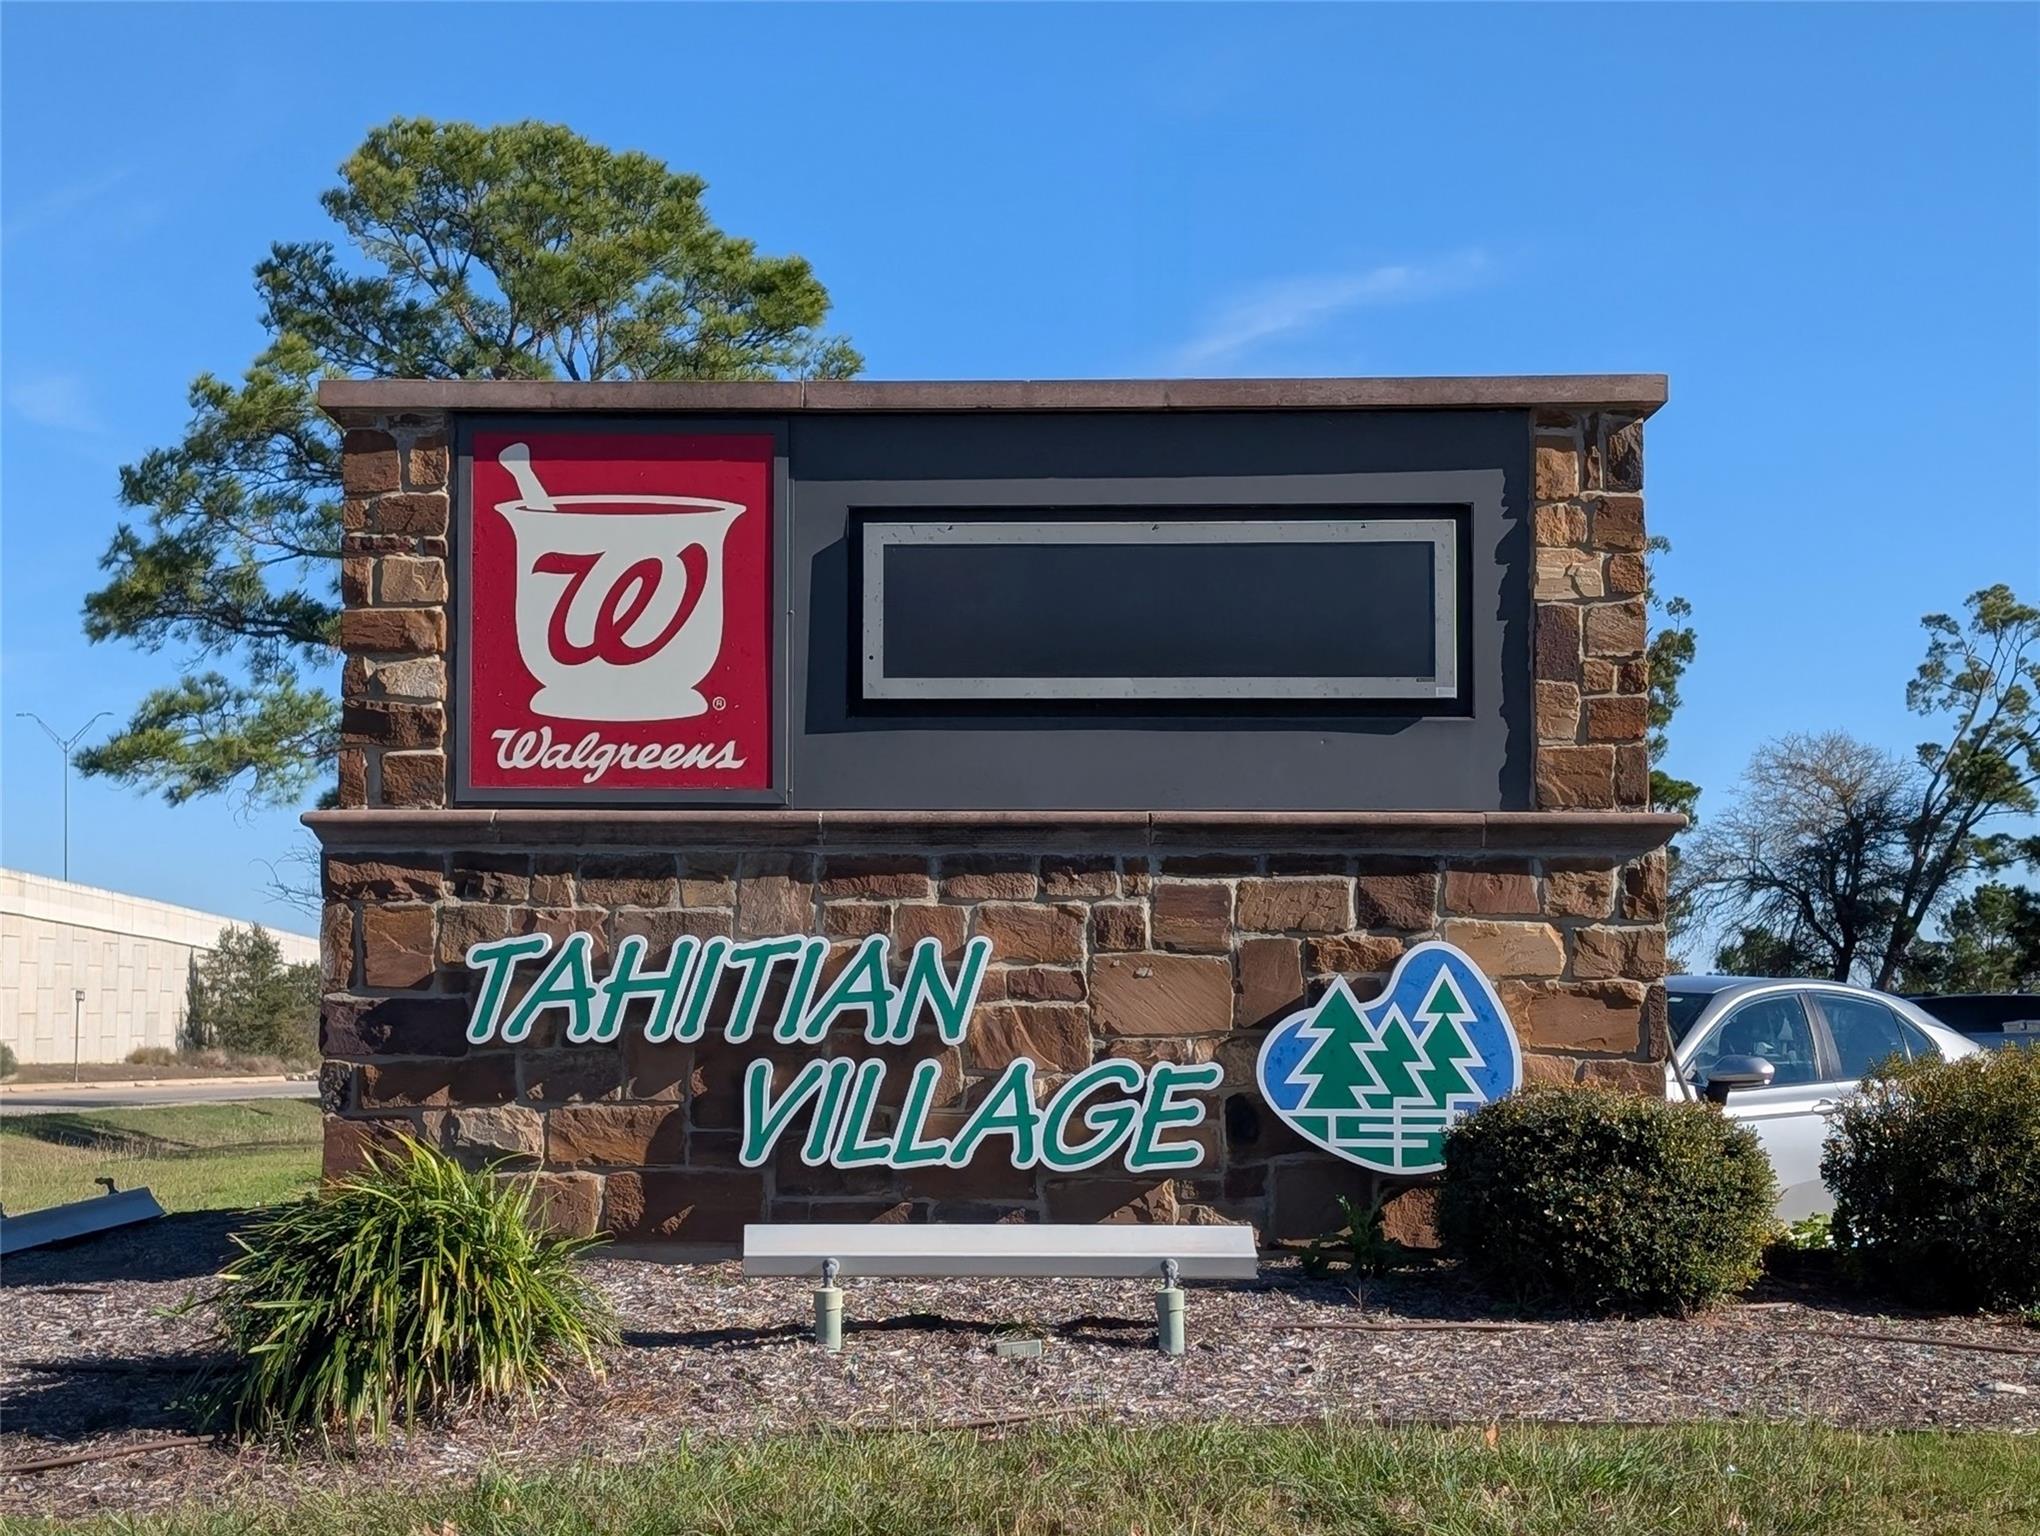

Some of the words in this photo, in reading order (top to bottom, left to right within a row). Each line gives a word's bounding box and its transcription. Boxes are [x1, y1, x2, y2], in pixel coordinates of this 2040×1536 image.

[490, 725, 747, 784] Walgreens
[466, 932, 993, 1046] TAHITIAN
[740, 1057, 1223, 1173] VILLAGE
